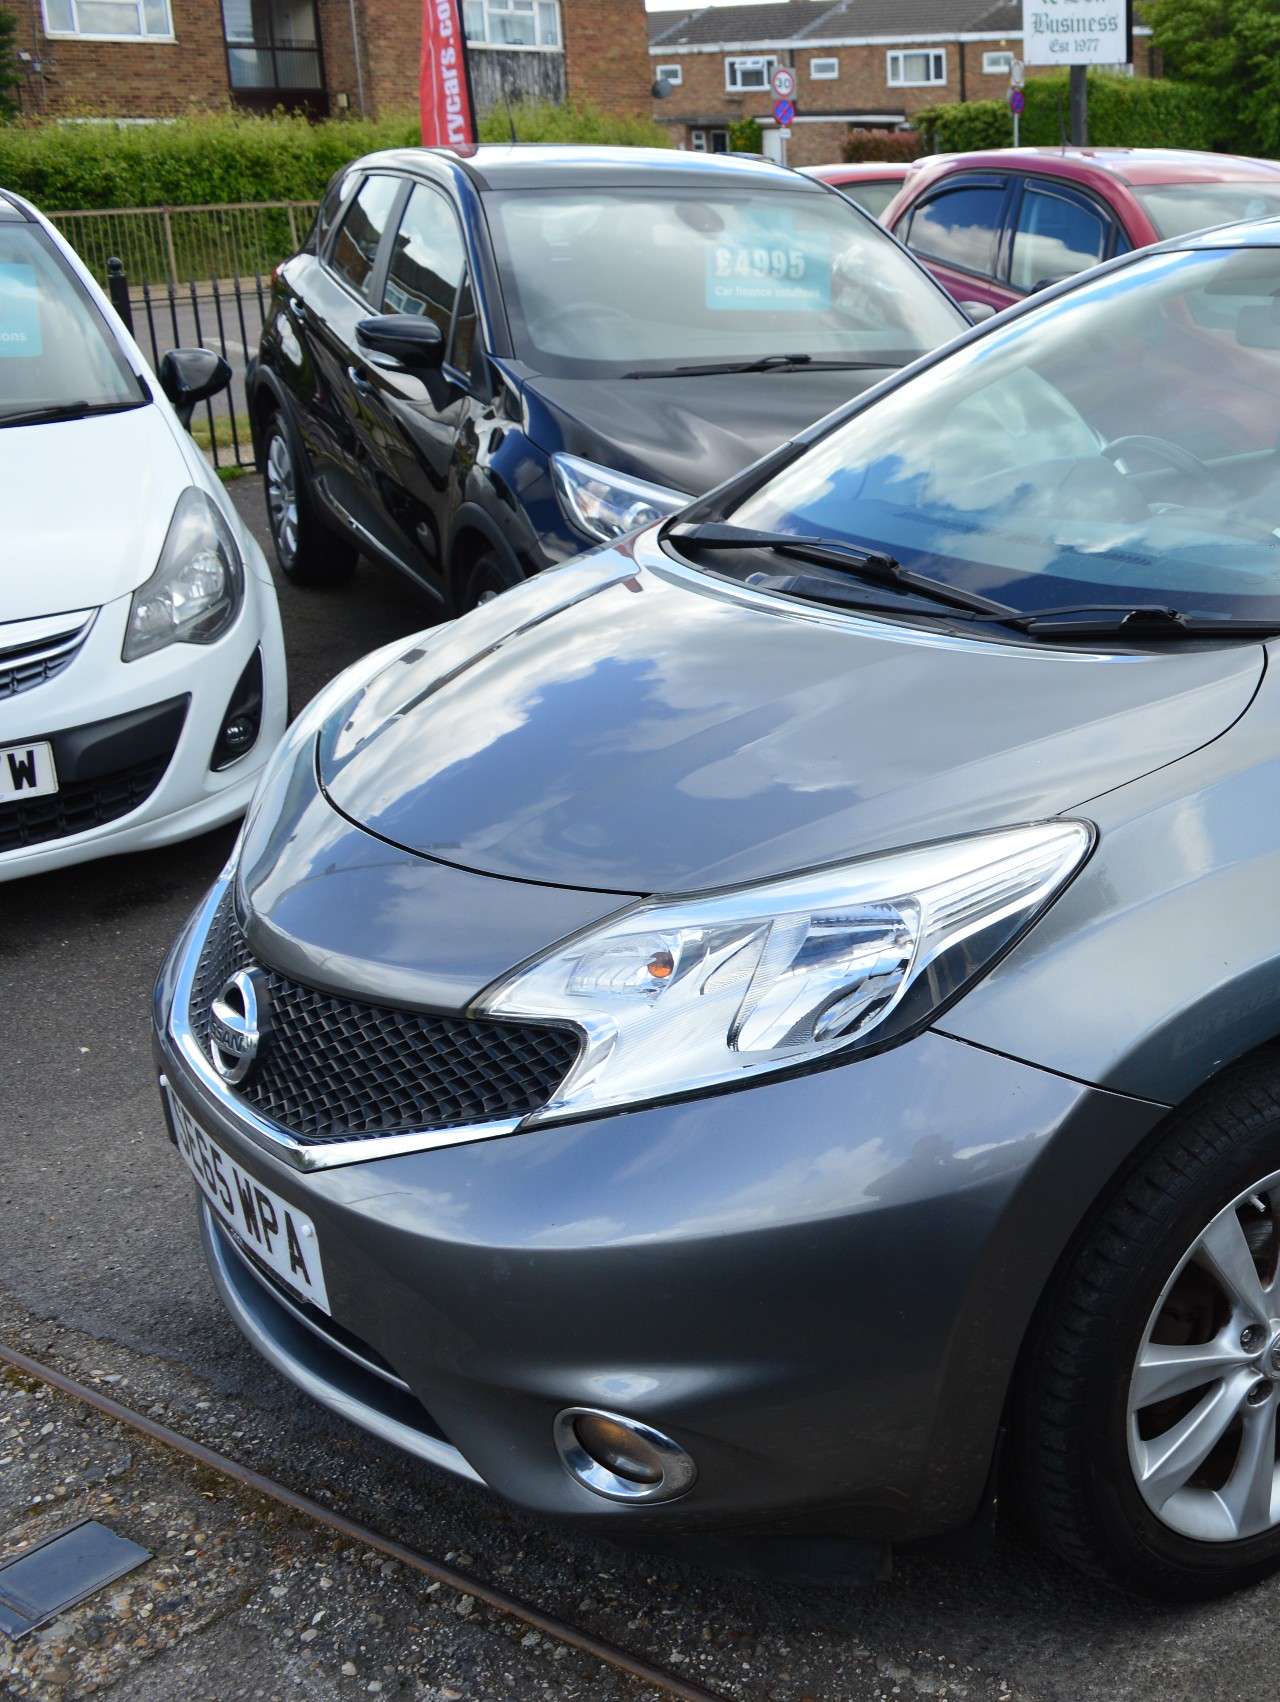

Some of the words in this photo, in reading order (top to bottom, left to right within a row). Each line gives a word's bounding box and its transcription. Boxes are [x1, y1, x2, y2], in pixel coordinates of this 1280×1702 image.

[1031, 12, 1118, 34] Business
[1049, 39, 1070, 53] Est
[1074, 38, 1099, 52] 1977
[436, 0, 465, 143] rycars.co
[775, 77, 789, 89] 30
[715, 247, 805, 280] £4995
[0, 749, 37, 791] W
[232, 1166, 312, 1287] WPA
